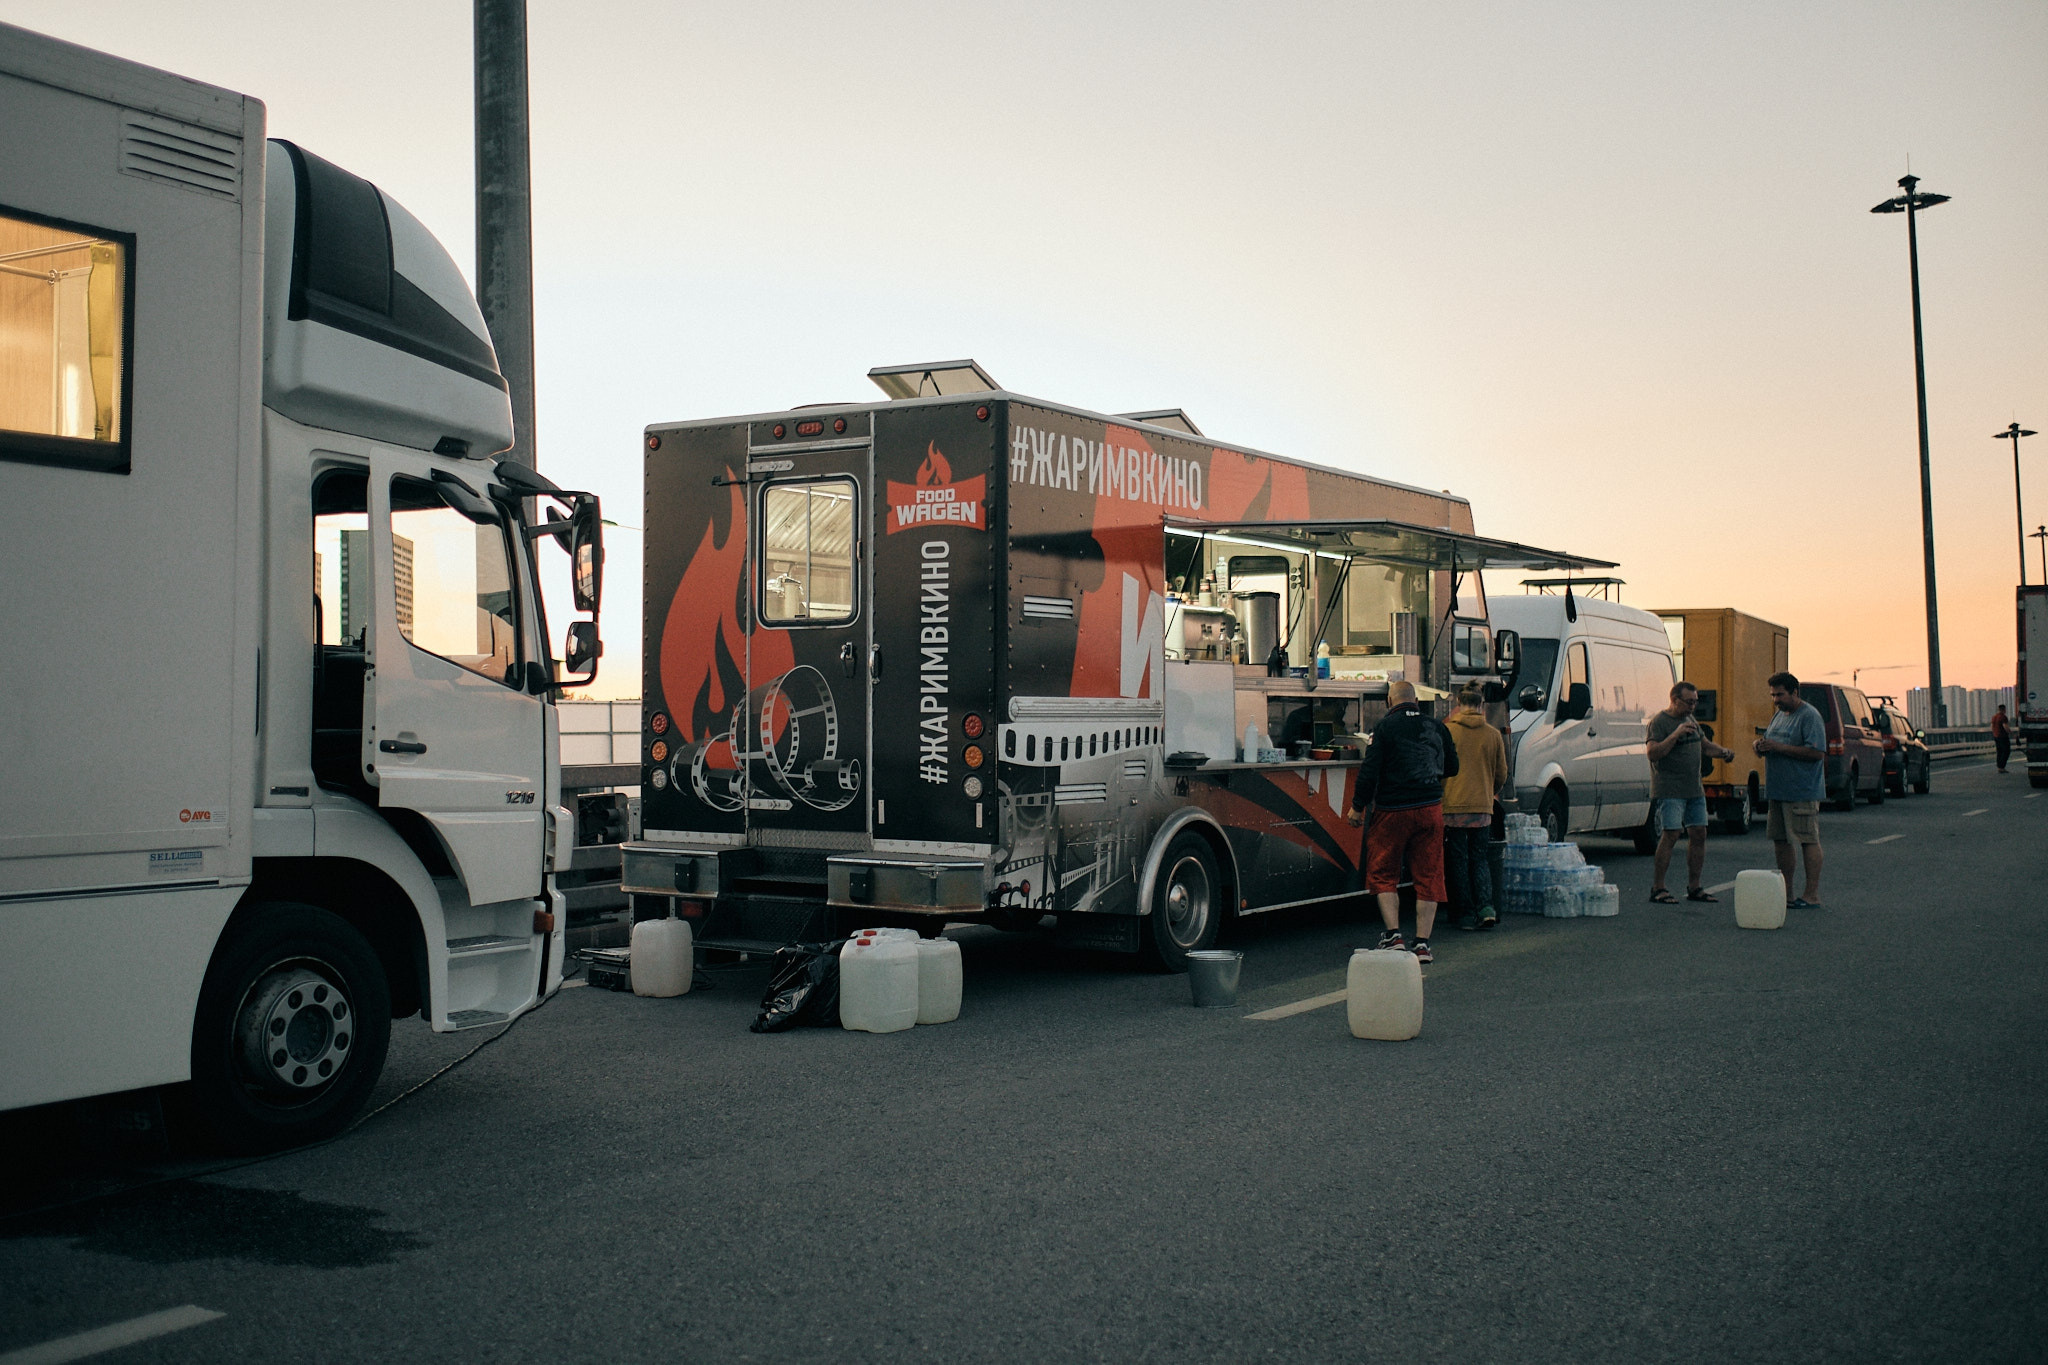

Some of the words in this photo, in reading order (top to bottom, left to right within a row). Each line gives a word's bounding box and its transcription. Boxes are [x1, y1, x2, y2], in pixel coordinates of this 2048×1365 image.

[1011, 425, 1202, 511] #ЖАРИМВКИНО
[916, 488, 956, 504] FOOD
[896, 501, 977, 527] WAGEN
[920, 541, 950, 785] #ЖАРИМВКИНО
[192, 811, 210, 819] AVG
